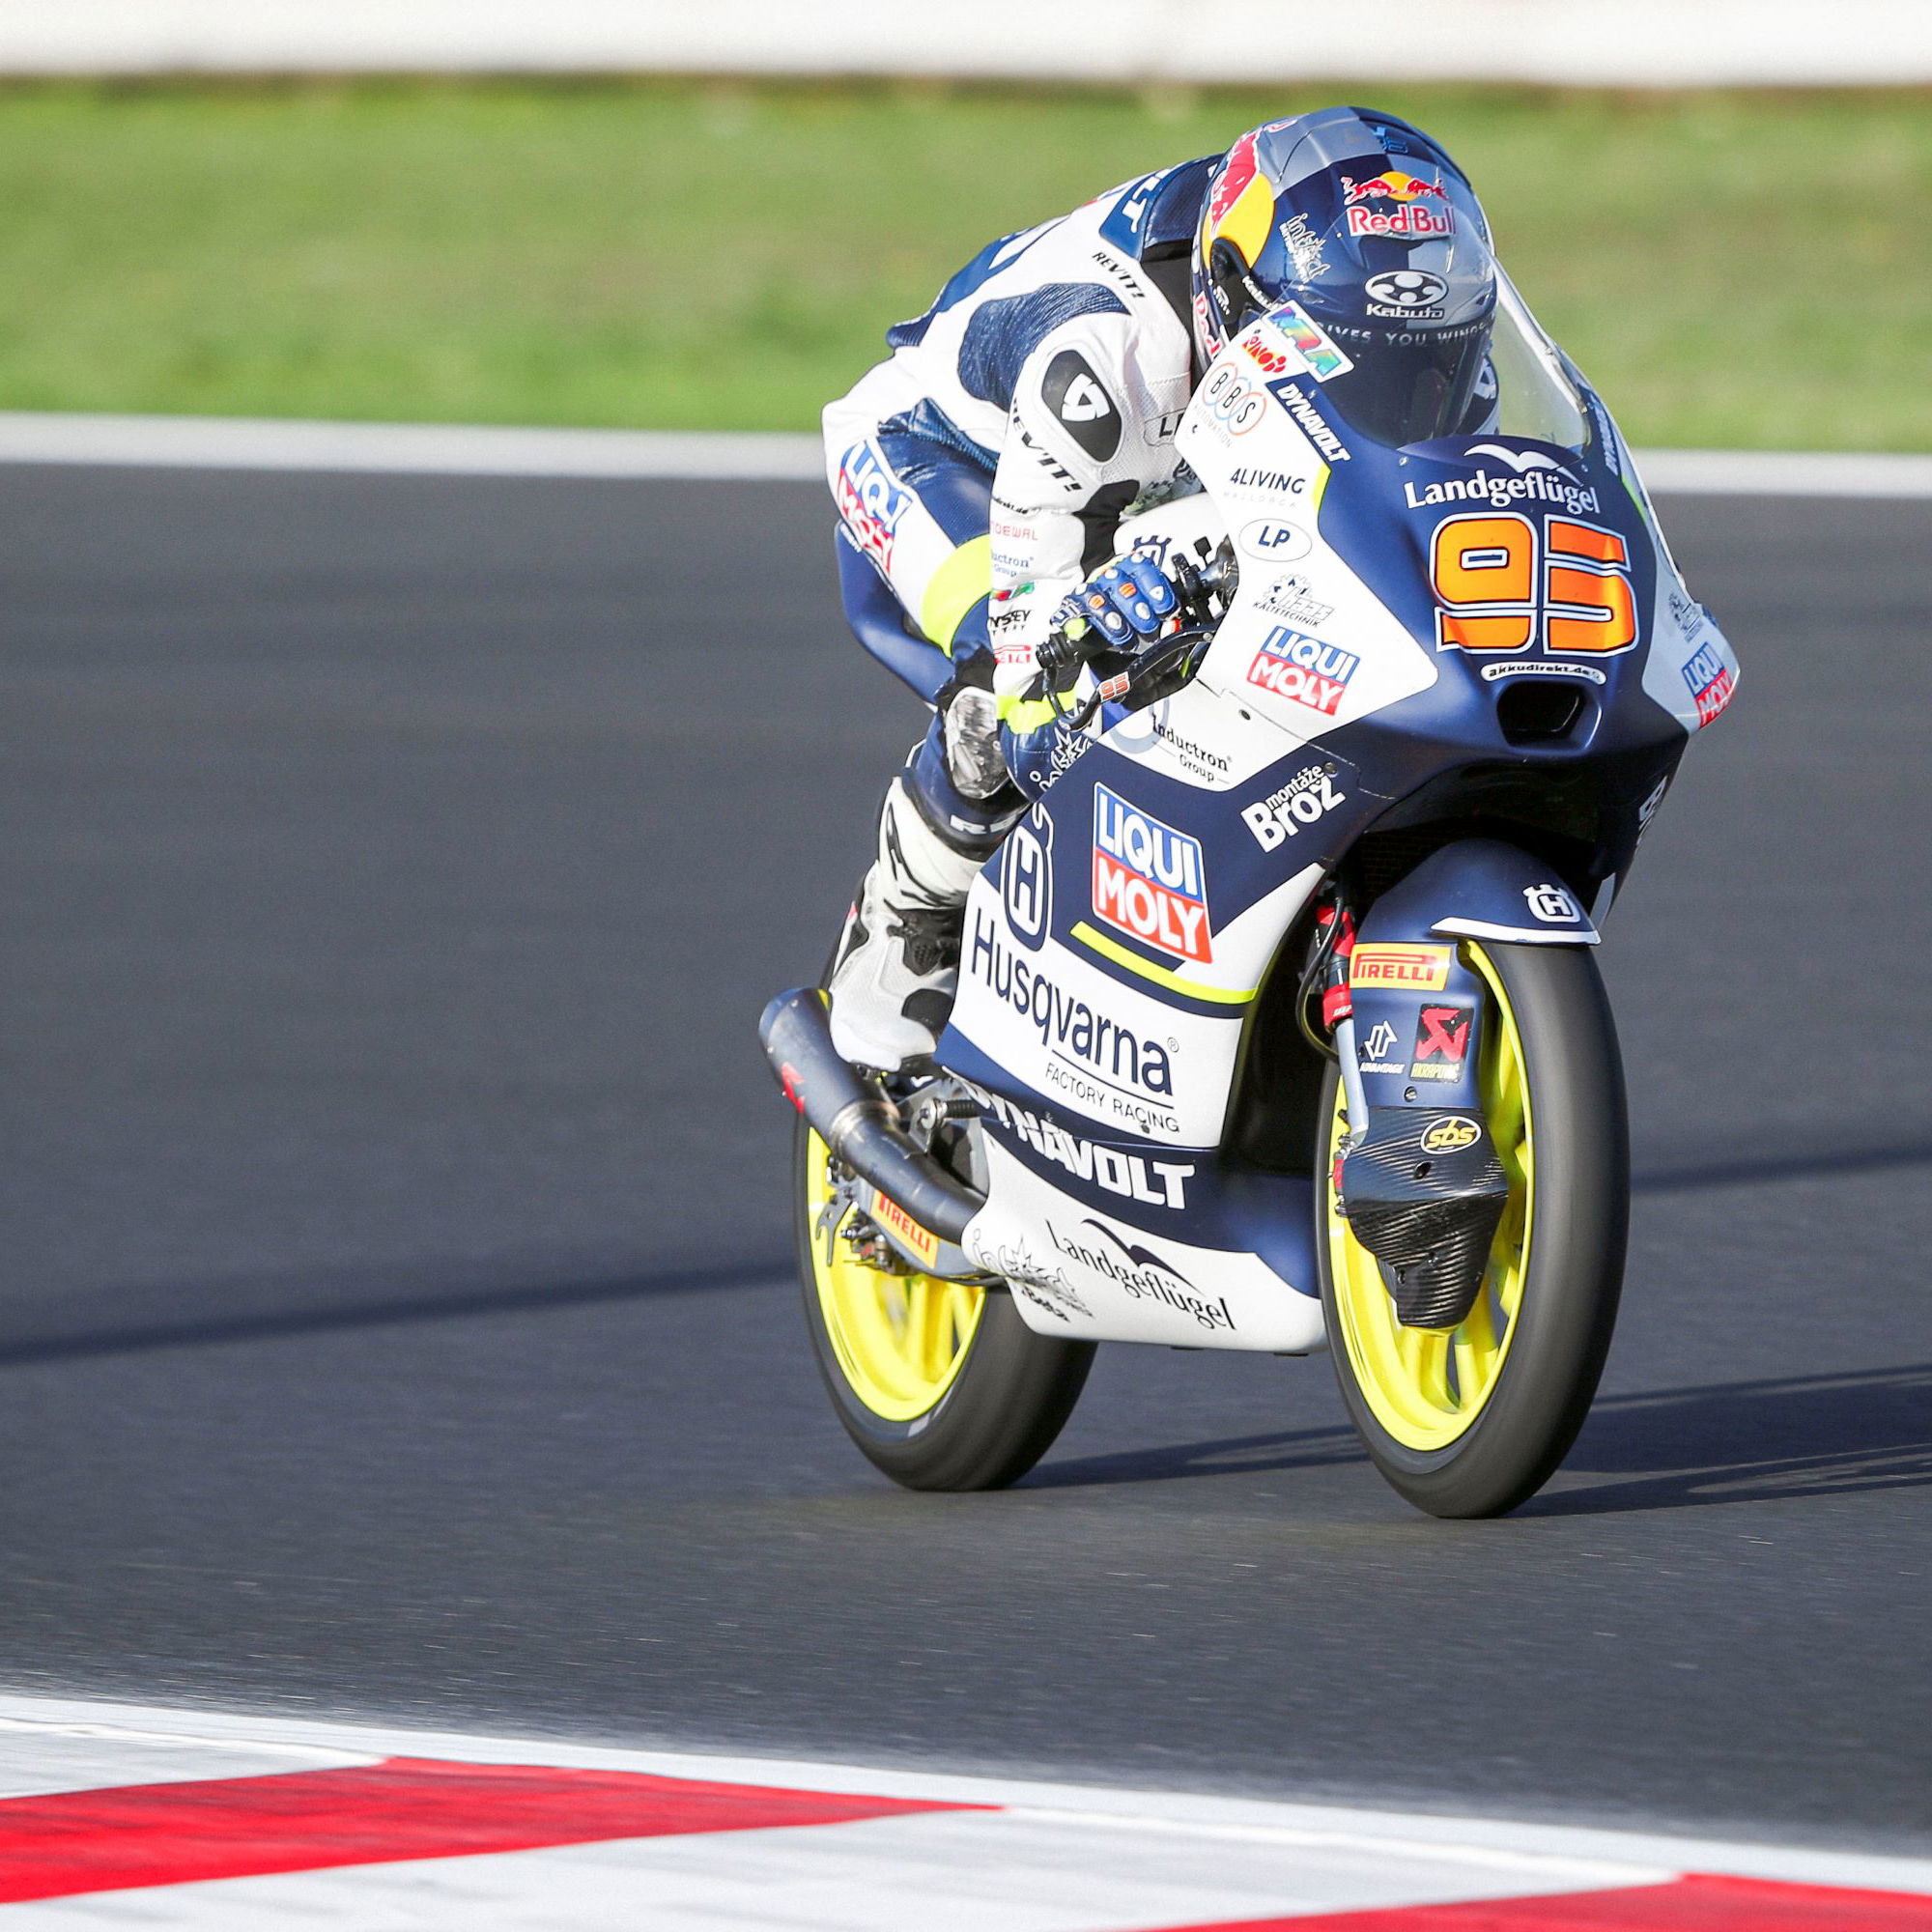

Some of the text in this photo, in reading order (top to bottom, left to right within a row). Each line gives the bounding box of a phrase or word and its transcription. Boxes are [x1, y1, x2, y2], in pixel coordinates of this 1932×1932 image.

[1349, 205, 1457, 235] Red Bull
[1366, 303, 1444, 319] Kabuto
[1385, 331, 1427, 347] YOU
[1210, 372, 1256, 424] BBS
[1276, 383, 1351, 462] DYNAVOLT
[1230, 468, 1306, 495] 4LIVING
[1404, 469, 1600, 515] Landgeflügel
[1258, 526, 1292, 549] LP
[1429, 511, 1640, 658] 95
[1264, 627, 1358, 684] LIQUI
[1683, 641, 1724, 696] LIQUI
[1249, 656, 1345, 712] MOLY
[1152, 714, 1229, 773] Inductron
[1179, 753, 1215, 783] Group
[1240, 776, 1347, 853] Brož
[1098, 789, 1199, 897] LIQUI
[1097, 856, 1205, 956] MOLY
[1352, 952, 1437, 981] PIRELLI
[971, 906, 1173, 1097] Husqvarna
[1045, 1062, 1180, 1133] FACTORY RACING
[1426, 1119, 1477, 1149] sbs
[1044, 1219, 1237, 1331] Landgeflügel
